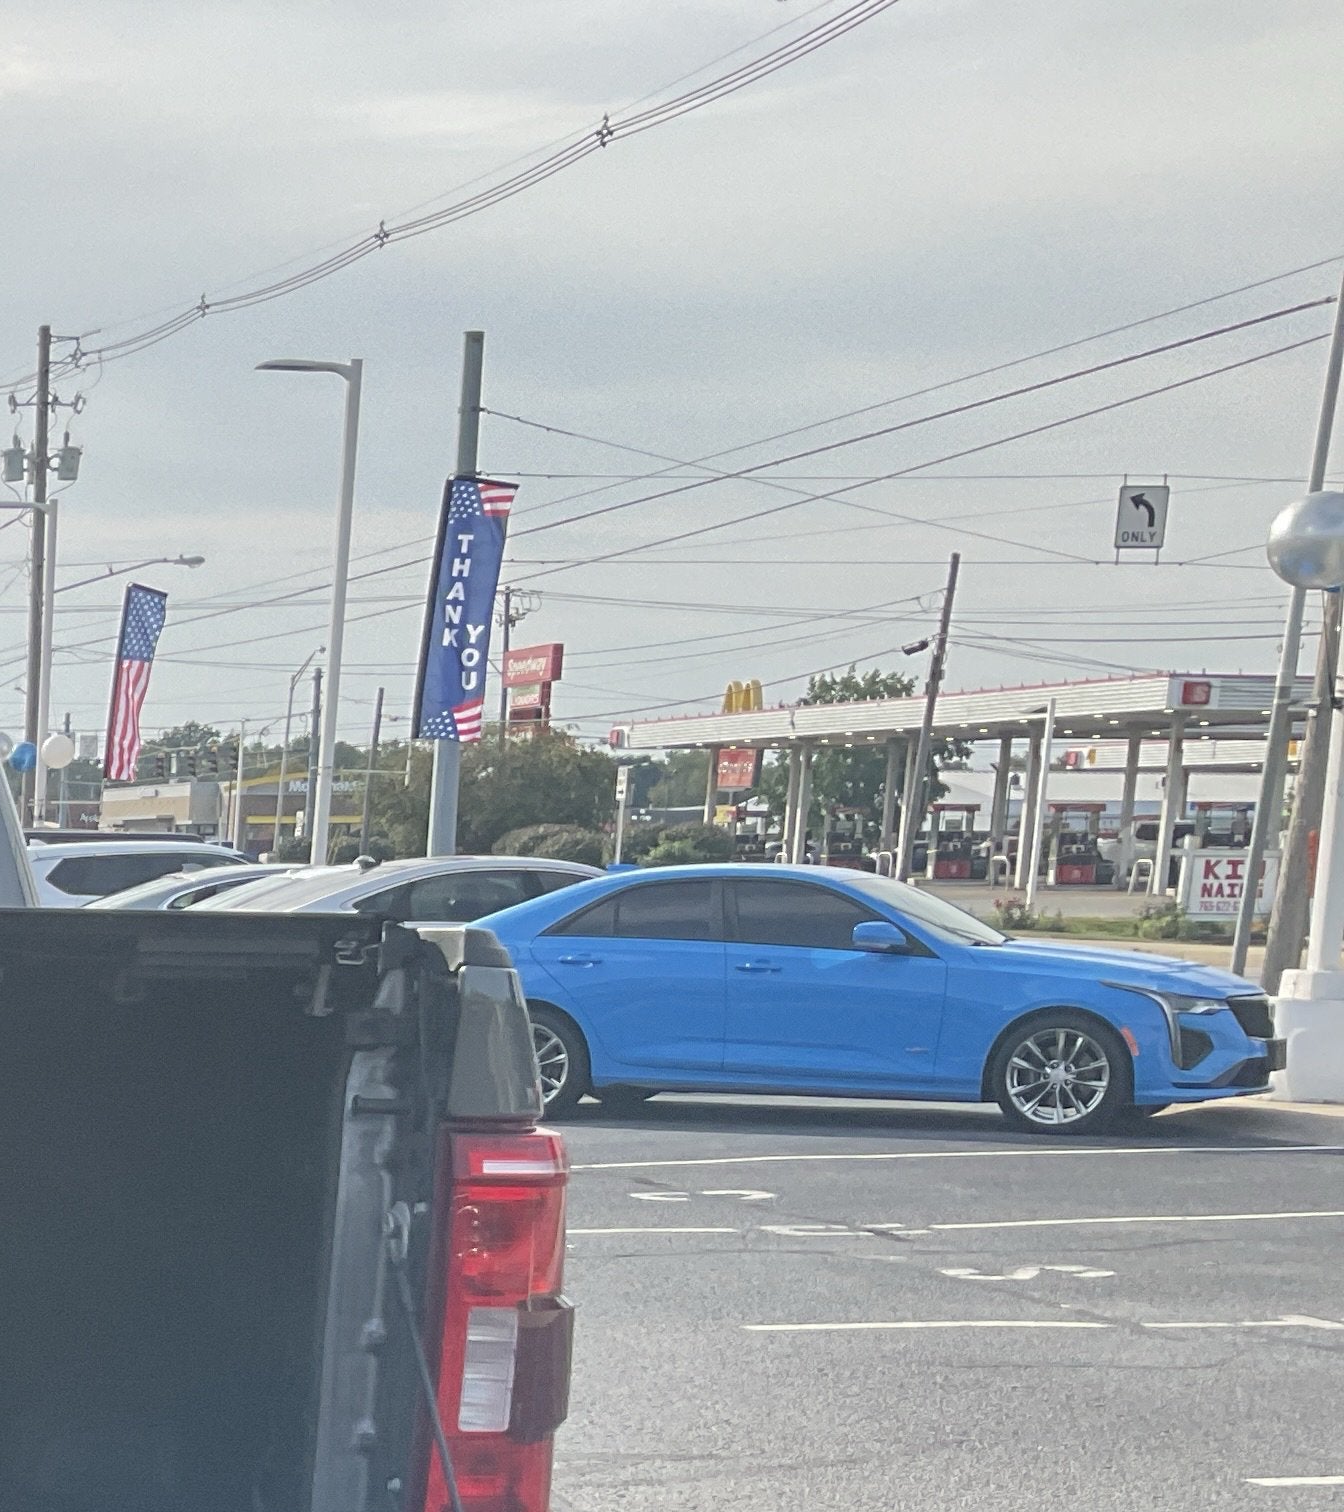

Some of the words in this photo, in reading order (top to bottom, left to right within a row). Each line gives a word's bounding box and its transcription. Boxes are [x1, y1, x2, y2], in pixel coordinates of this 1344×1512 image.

[1121, 530, 1158, 543] ONLY
[441, 533, 475, 648] THANK
[460, 623, 486, 691] YOU
